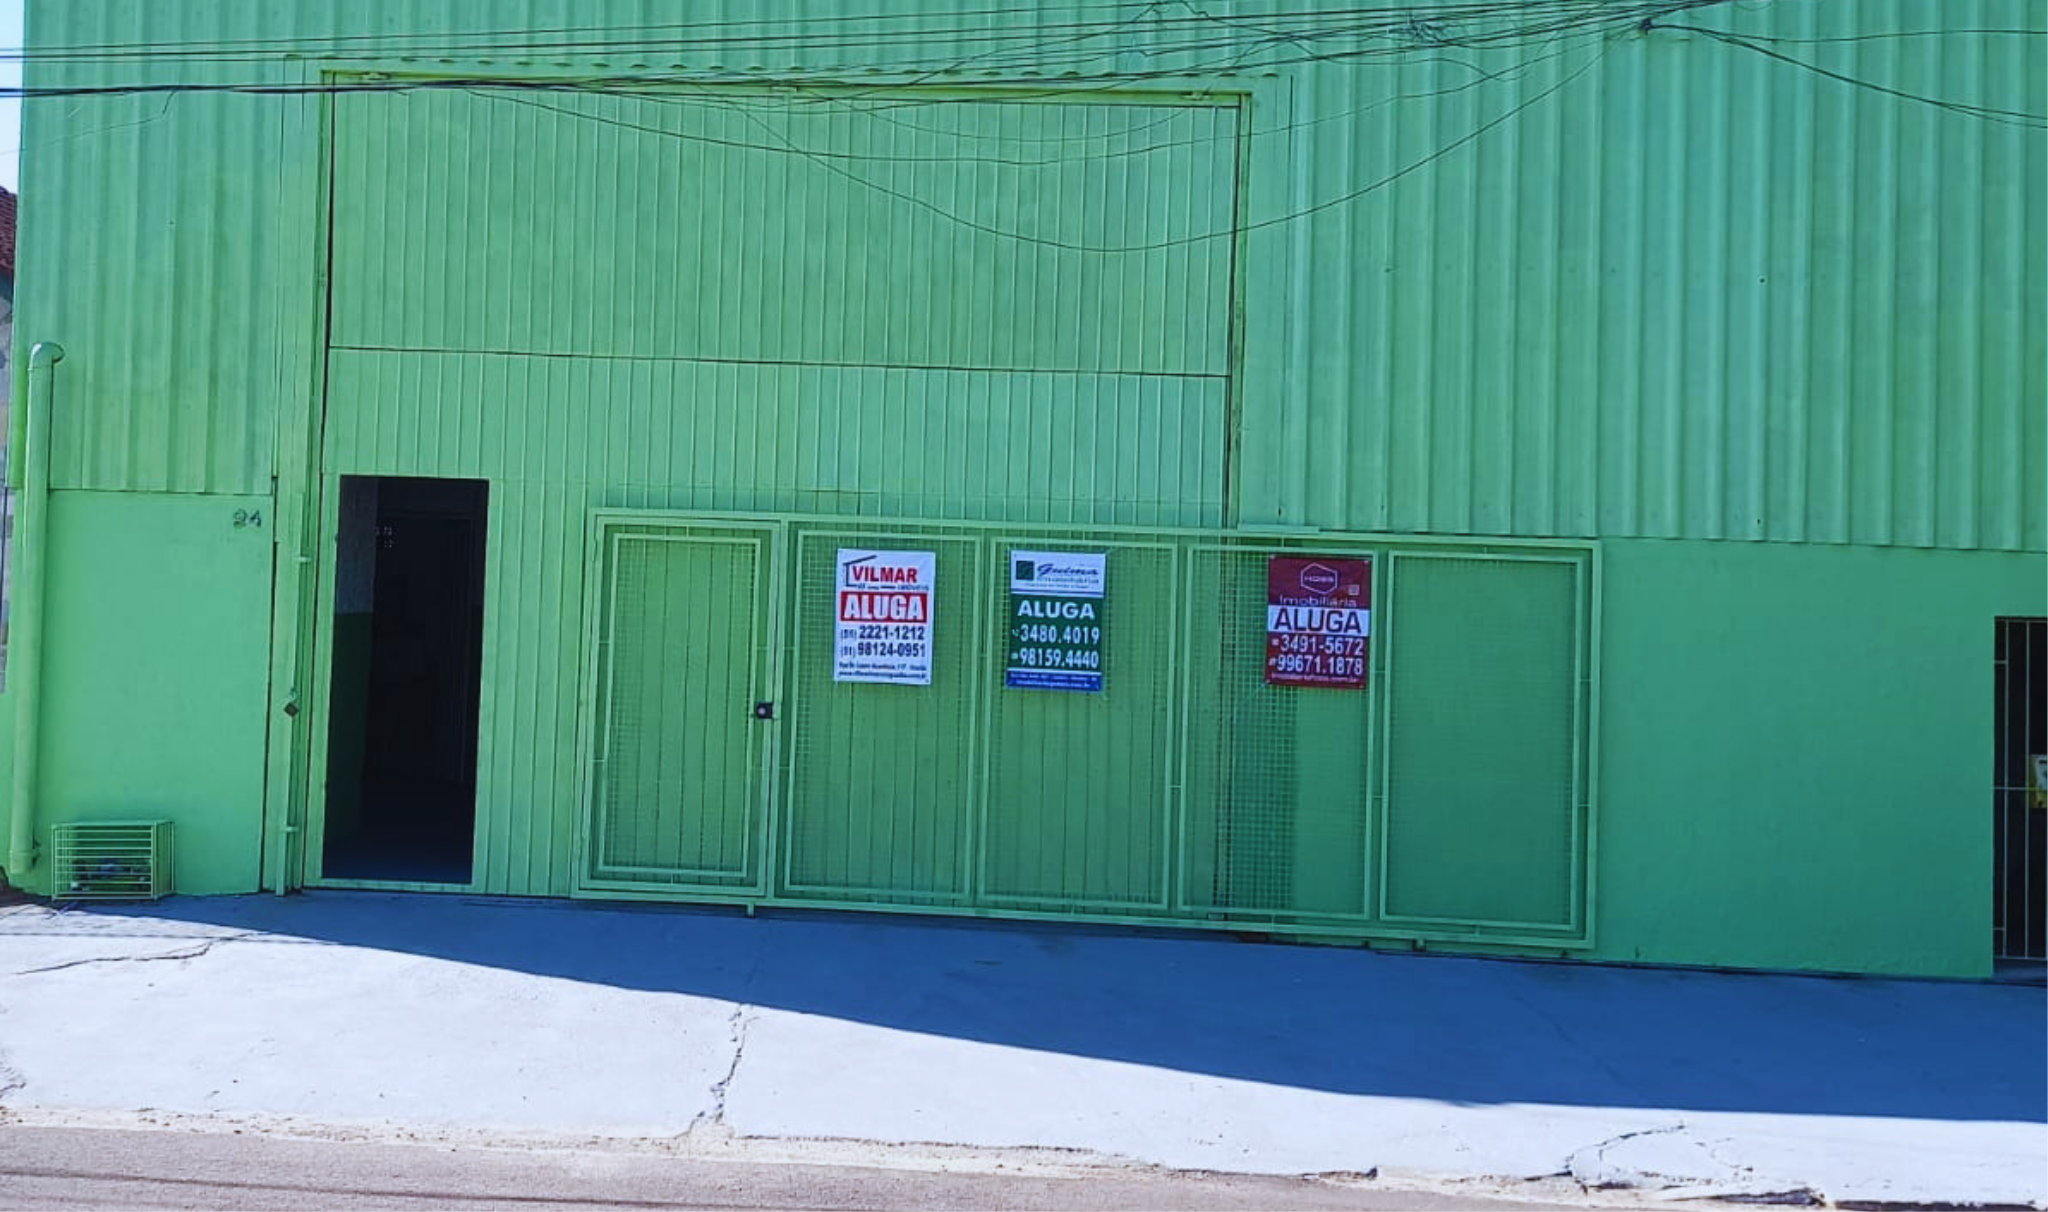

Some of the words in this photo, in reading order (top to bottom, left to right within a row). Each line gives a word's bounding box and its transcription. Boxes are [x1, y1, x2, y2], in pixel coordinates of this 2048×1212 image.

[852, 565, 918, 583] VILMAR
[843, 593, 925, 621] ALUGA
[1018, 600, 1095, 620] ALUGA
[1274, 607, 1362, 633] ALUGA
[858, 625, 925, 641] 2221-1212
[1020, 623, 1100, 644] 3480.4019
[857, 642, 926, 658] 98124-0951
[1280, 634, 1364, 656] 3491-5672
[1019, 647, 1099, 669] 98159.4440
[1276, 655, 1364, 676] 99671.1878
